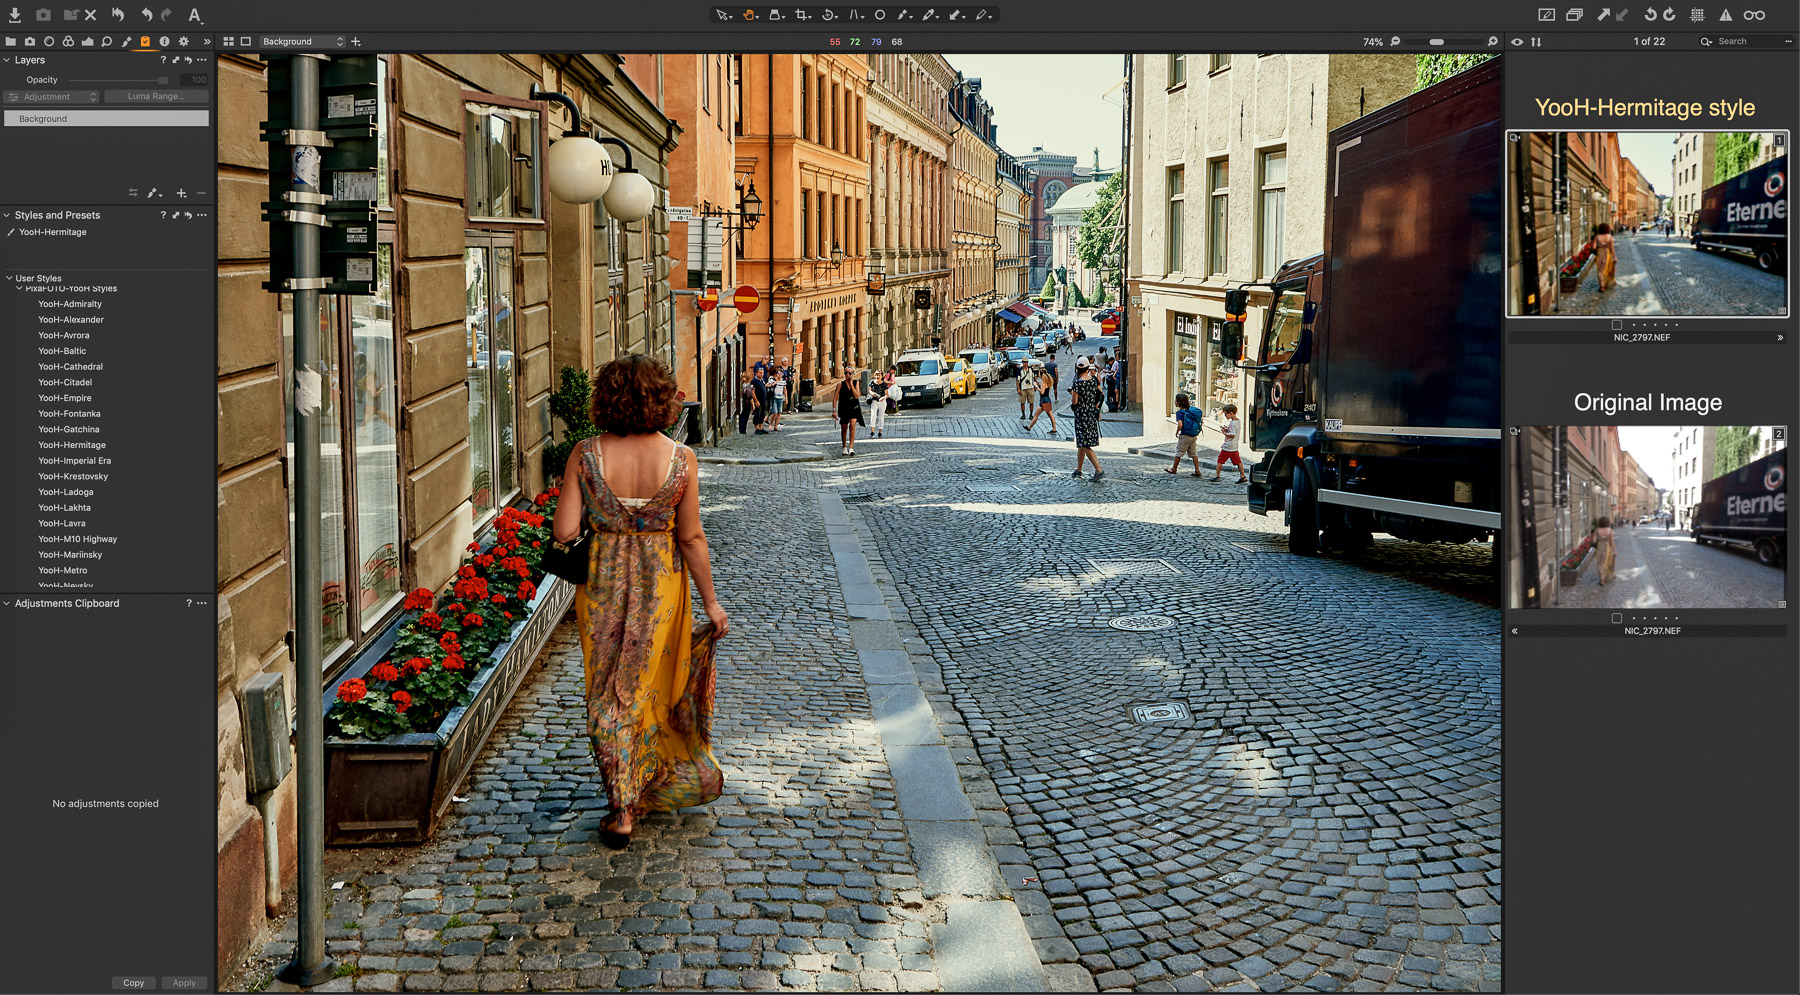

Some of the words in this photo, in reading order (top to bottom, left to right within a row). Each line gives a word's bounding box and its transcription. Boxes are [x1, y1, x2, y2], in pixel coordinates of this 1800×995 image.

[264, 38, 312, 47] Background
[830, 38, 841, 46] 55
[850, 38, 861, 46] 72
[871, 38, 882, 46] 79
[891, 38, 903, 46] 68
[1363, 38, 1384, 46] 74%
[1634, 37, 1639, 45] 1
[1641, 37, 1651, 45] of
[1653, 37, 1666, 46] 22
[1718, 37, 1747, 46] Search
[15, 55, 45, 66] Layers
[161, 55, 167, 64] ?
[27, 76, 58, 85] Opacity
[192, 76, 207, 84] 100
[24, 92, 71, 102] Adjustment
[128, 92, 151, 101] Luma
[153, 92, 185, 102] Range...
[19, 114, 68, 124] Background
[15, 210, 43, 221] Styles
[45, 210, 64, 220] and
[66, 210, 101, 220] Presets
[161, 210, 167, 220] ?
[19, 227, 87, 238] YooH-Hermitage
[15, 274, 35, 284] User
[36, 274, 62, 285] Styles
[92, 286, 118, 294] Styles
[38, 299, 103, 310] YooH-Admiralty
[38, 315, 105, 324] YooH-Alexander
[1177, 316, 1185, 333] El
[37, 331, 91, 340] YooH-Avrora
[1613, 333, 1671, 343] NIC_2797.NEF
[38, 346, 88, 355] YooH-Baltic
[38, 362, 104, 371] YooH-Cathedral
[38, 377, 94, 387] YooH-Citadel
[38, 393, 93, 404] YooH-Empire
[38, 409, 102, 418] YooH-Fontanka
[38, 425, 101, 434] YooH-Gatchina
[1776, 430, 1782, 438] 2
[38, 440, 108, 451] YooH-Hermitage
[38, 456, 98, 467] YooH-Imperial
[98, 456, 112, 465] Era
[38, 472, 110, 483] YooH-Krestovsky
[38, 487, 95, 498] YooH-Ladoga
[38, 503, 92, 512] YooH-Lakhta
[38, 519, 87, 528] YooH-Lavra
[38, 534, 82, 543] YooH-M10
[82, 534, 118, 545] Highway
[38, 550, 104, 562] YooH-Mariinsky
[38, 566, 89, 575] YooH-Metro
[15, 597, 73, 610] Adjustments
[74, 597, 120, 610] Clipboard
[186, 598, 193, 608] ?
[1624, 626, 1682, 636] NIC_2797.NEF
[459, 680, 502, 764] LADY
[502, 585, 562, 692] HAMILTON
[52, 799, 66, 808] No
[68, 798, 125, 810] adjustments
[127, 798, 160, 810] copied
[123, 978, 145, 989] Copy
[173, 978, 197, 989] Apply
